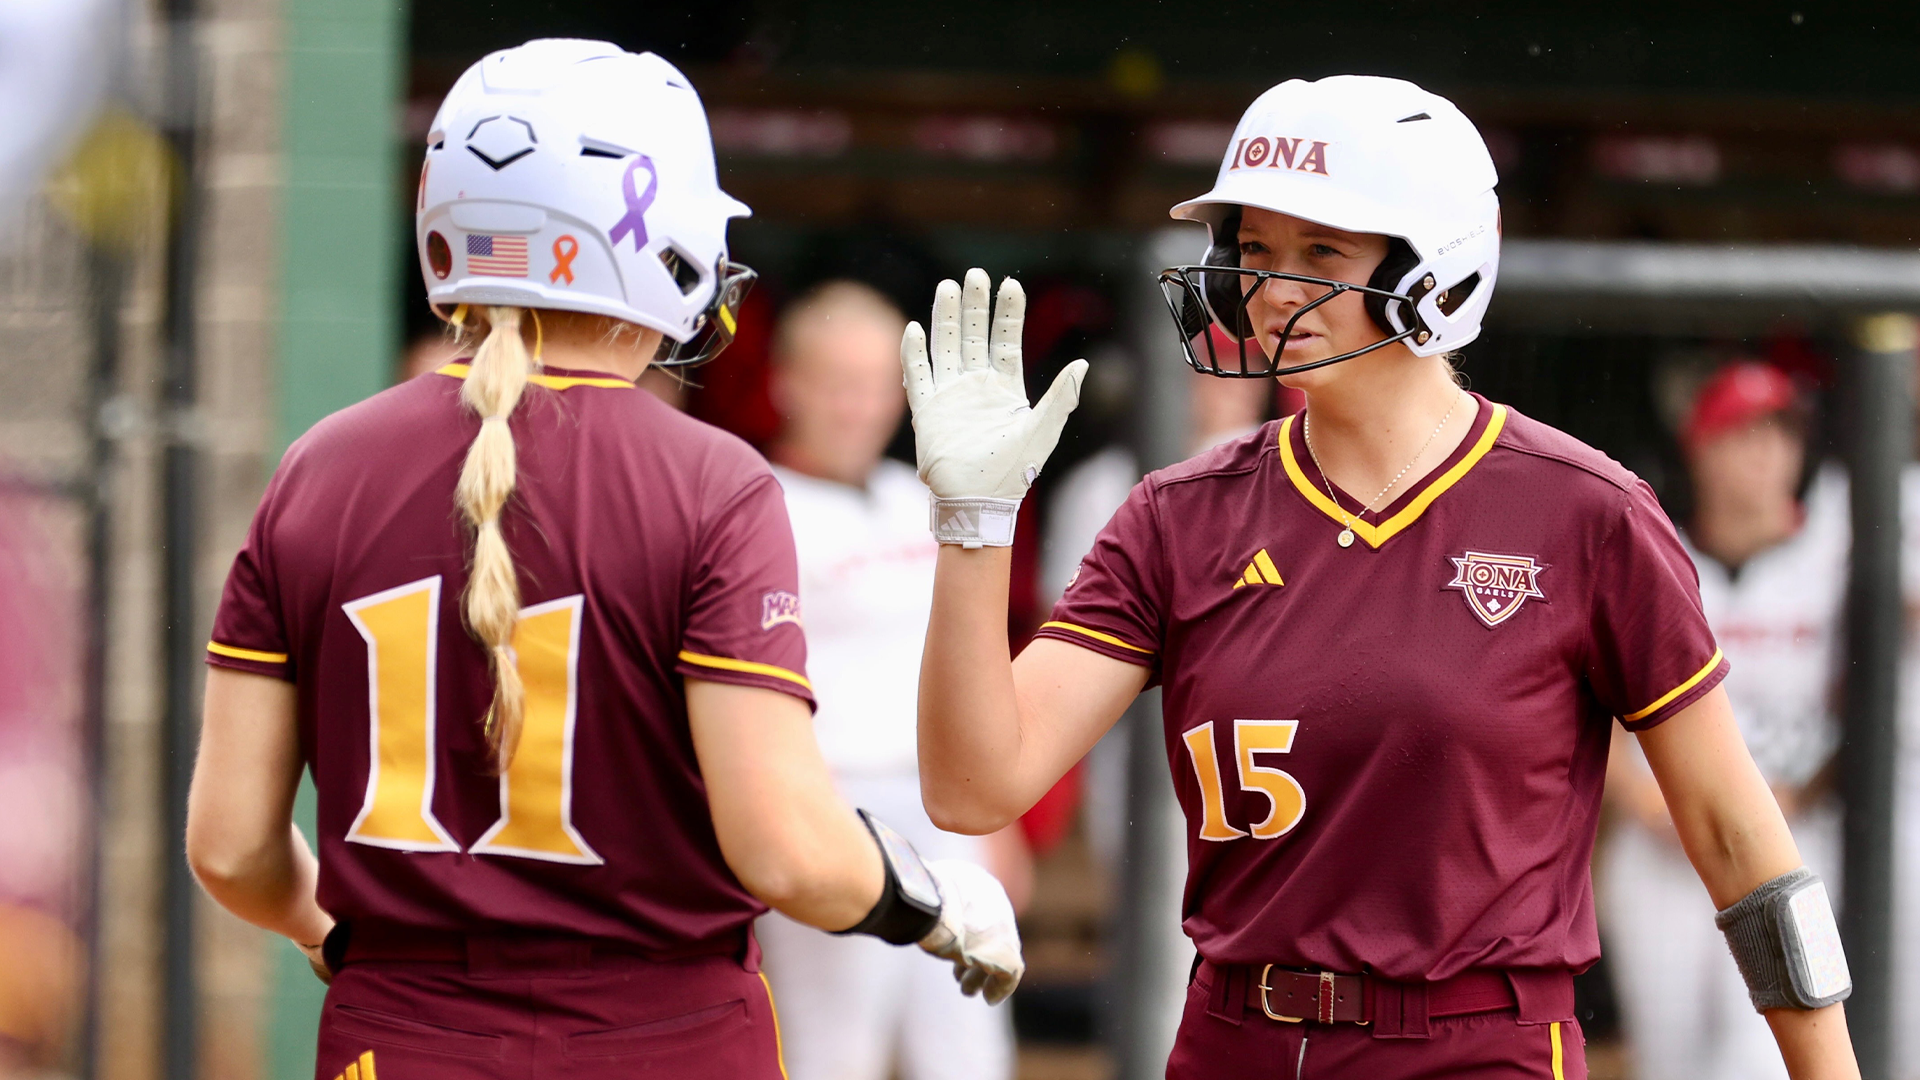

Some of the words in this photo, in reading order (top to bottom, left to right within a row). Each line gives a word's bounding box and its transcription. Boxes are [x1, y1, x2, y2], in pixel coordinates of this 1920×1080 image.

[1229, 136, 1330, 177] IONA
[1457, 561, 1537, 593] IONA
[1476, 588, 1514, 599] GAELS
[341, 574, 605, 866] 11
[1182, 719, 1307, 842] 15
